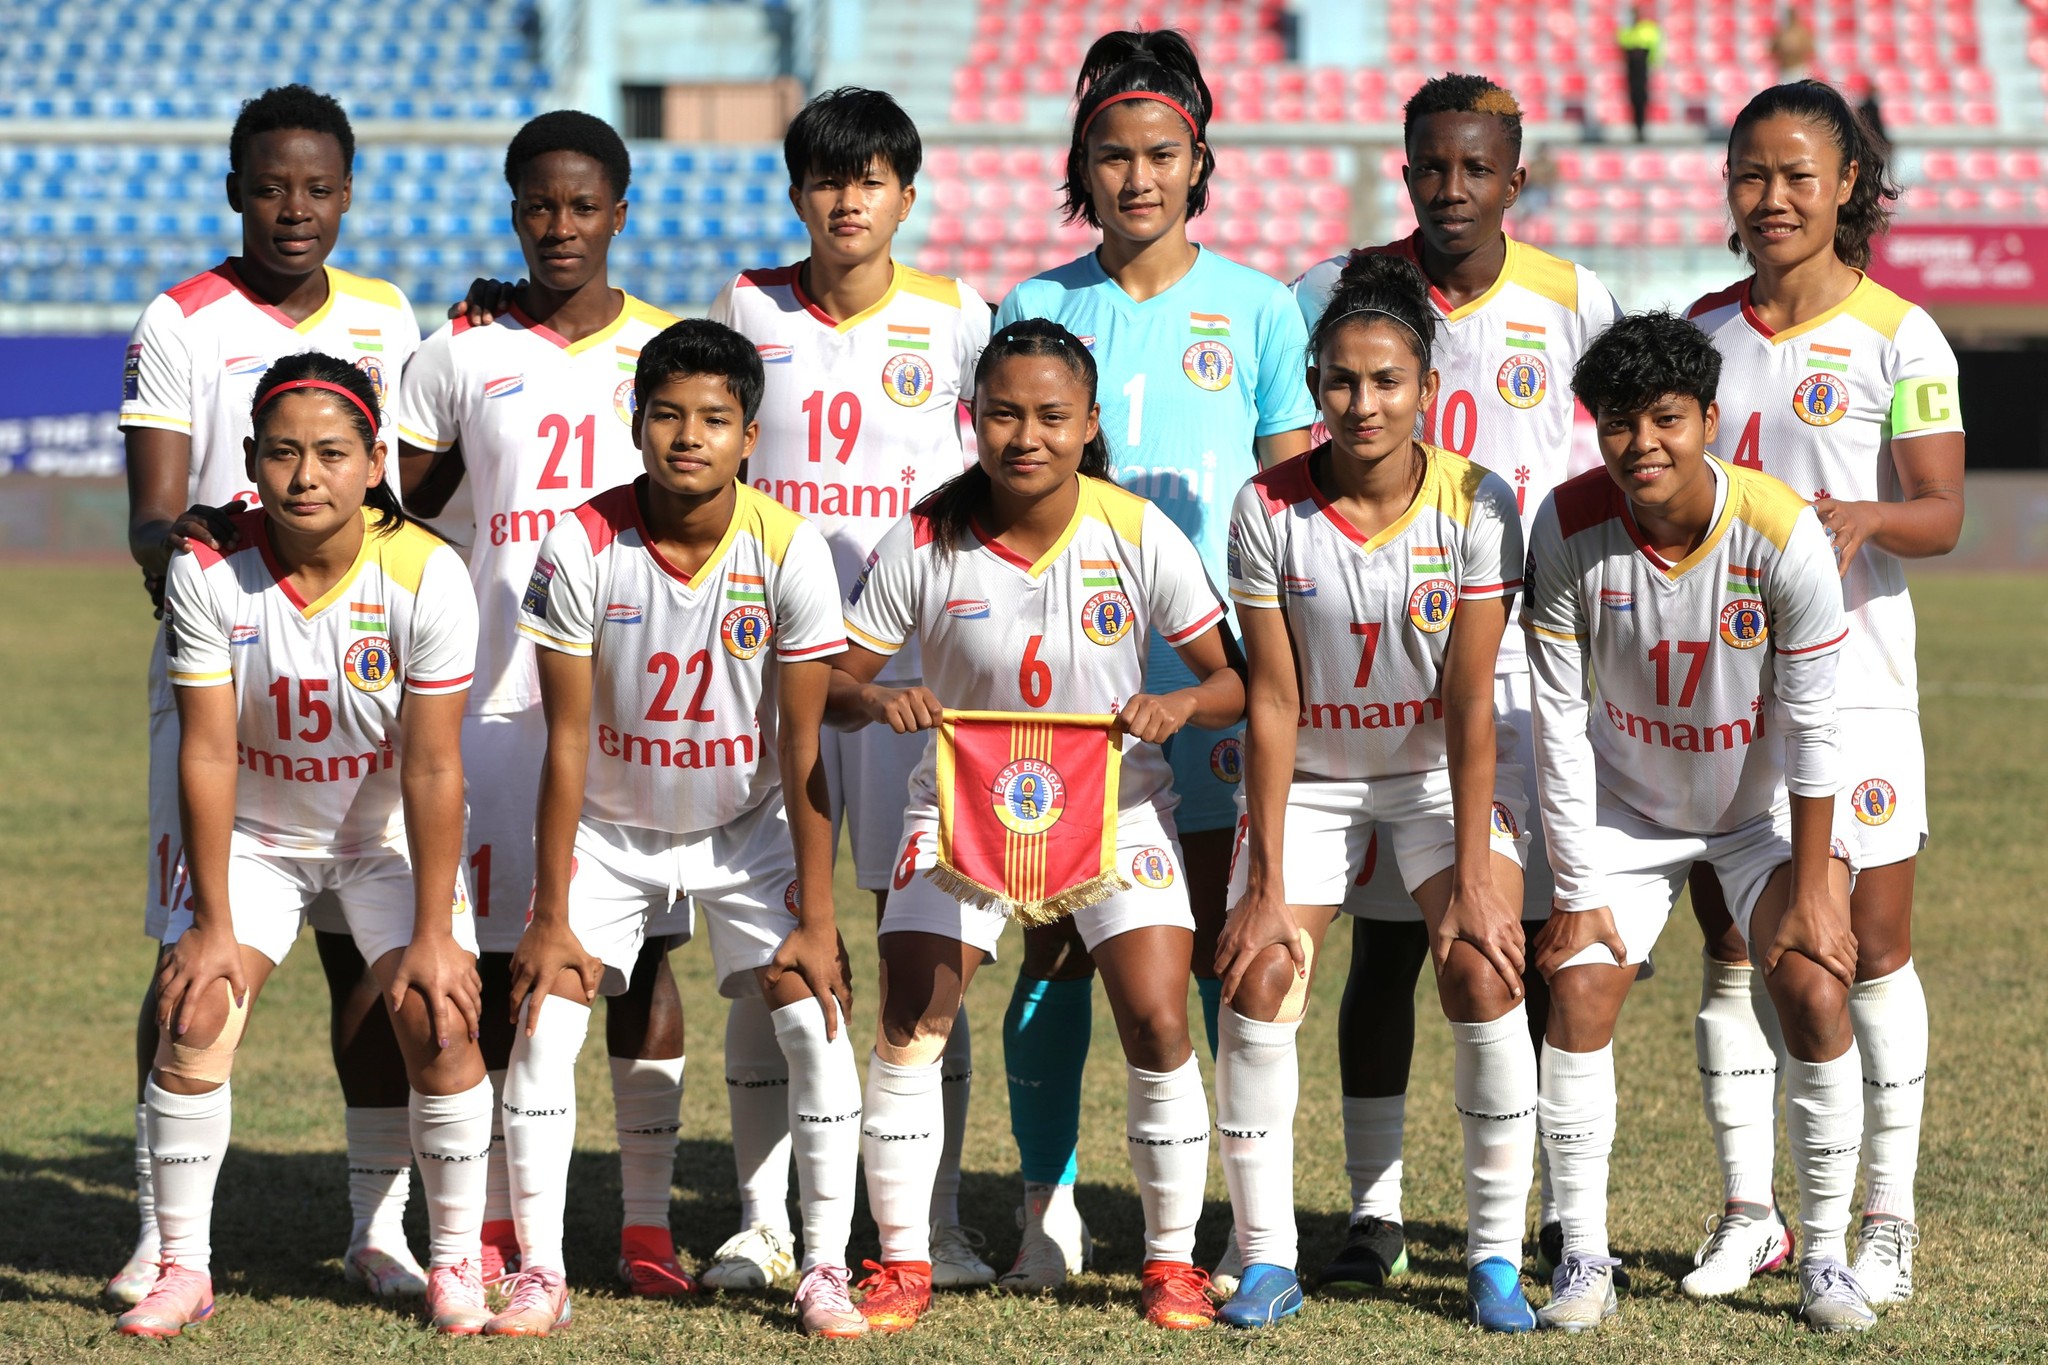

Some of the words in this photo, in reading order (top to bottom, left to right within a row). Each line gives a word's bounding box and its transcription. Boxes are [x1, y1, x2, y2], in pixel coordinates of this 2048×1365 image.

[1500, 358, 1518, 379] EAST
[1797, 376, 1817, 396] EAST
[1123, 373, 1146, 446] 1
[1916, 382, 1949, 422] C
[801, 391, 862, 465] 19
[1732, 412, 1763, 471] 4
[536, 414, 596, 490] 21
[1083, 597, 1101, 620] EAST
[1103, 593, 1132, 616] BENGAL
[1411, 584, 1429, 607] EAST
[1721, 603, 1739, 623] EAST
[724, 610, 742, 631] EAST
[346, 641, 366, 664] EAST
[1019, 635, 1052, 708] 6
[1350, 622, 1381, 687] 7
[644, 649, 714, 722] 22
[1648, 640, 1710, 707] 17
[269, 676, 332, 743] 15
[1298, 698, 1443, 729] mam
[1605, 695, 1765, 752] emami
[995, 764, 1018, 794] EAST
[1023, 761, 1063, 800] BENGAL
[1853, 784, 1866, 806] EAST
[1698, 1064, 1780, 1077] AK-ONLY
[502, 1101, 568, 1117] AK-ONLY
